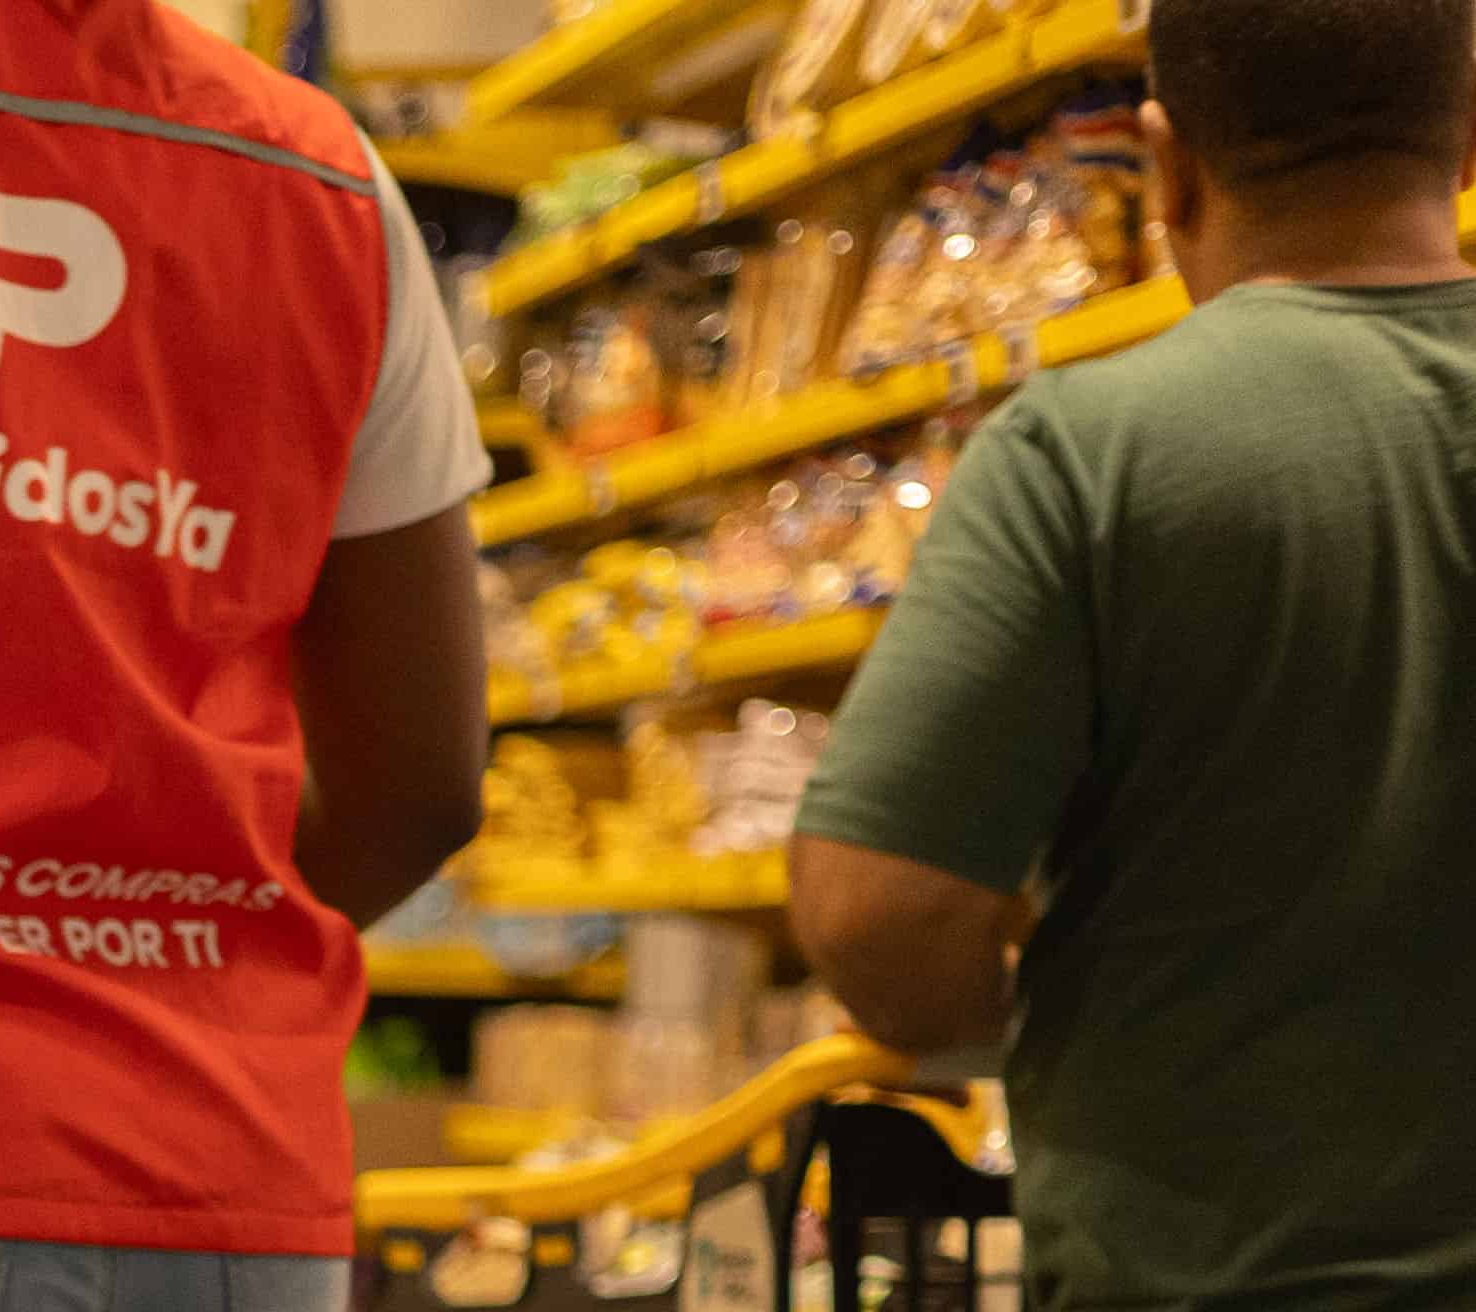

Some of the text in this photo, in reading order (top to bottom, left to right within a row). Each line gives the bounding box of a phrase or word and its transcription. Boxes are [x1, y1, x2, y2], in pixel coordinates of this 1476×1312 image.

[16, 860, 284, 912] COMPRAS
[59, 916, 171, 969] POR
[171, 919, 223, 969] TI
